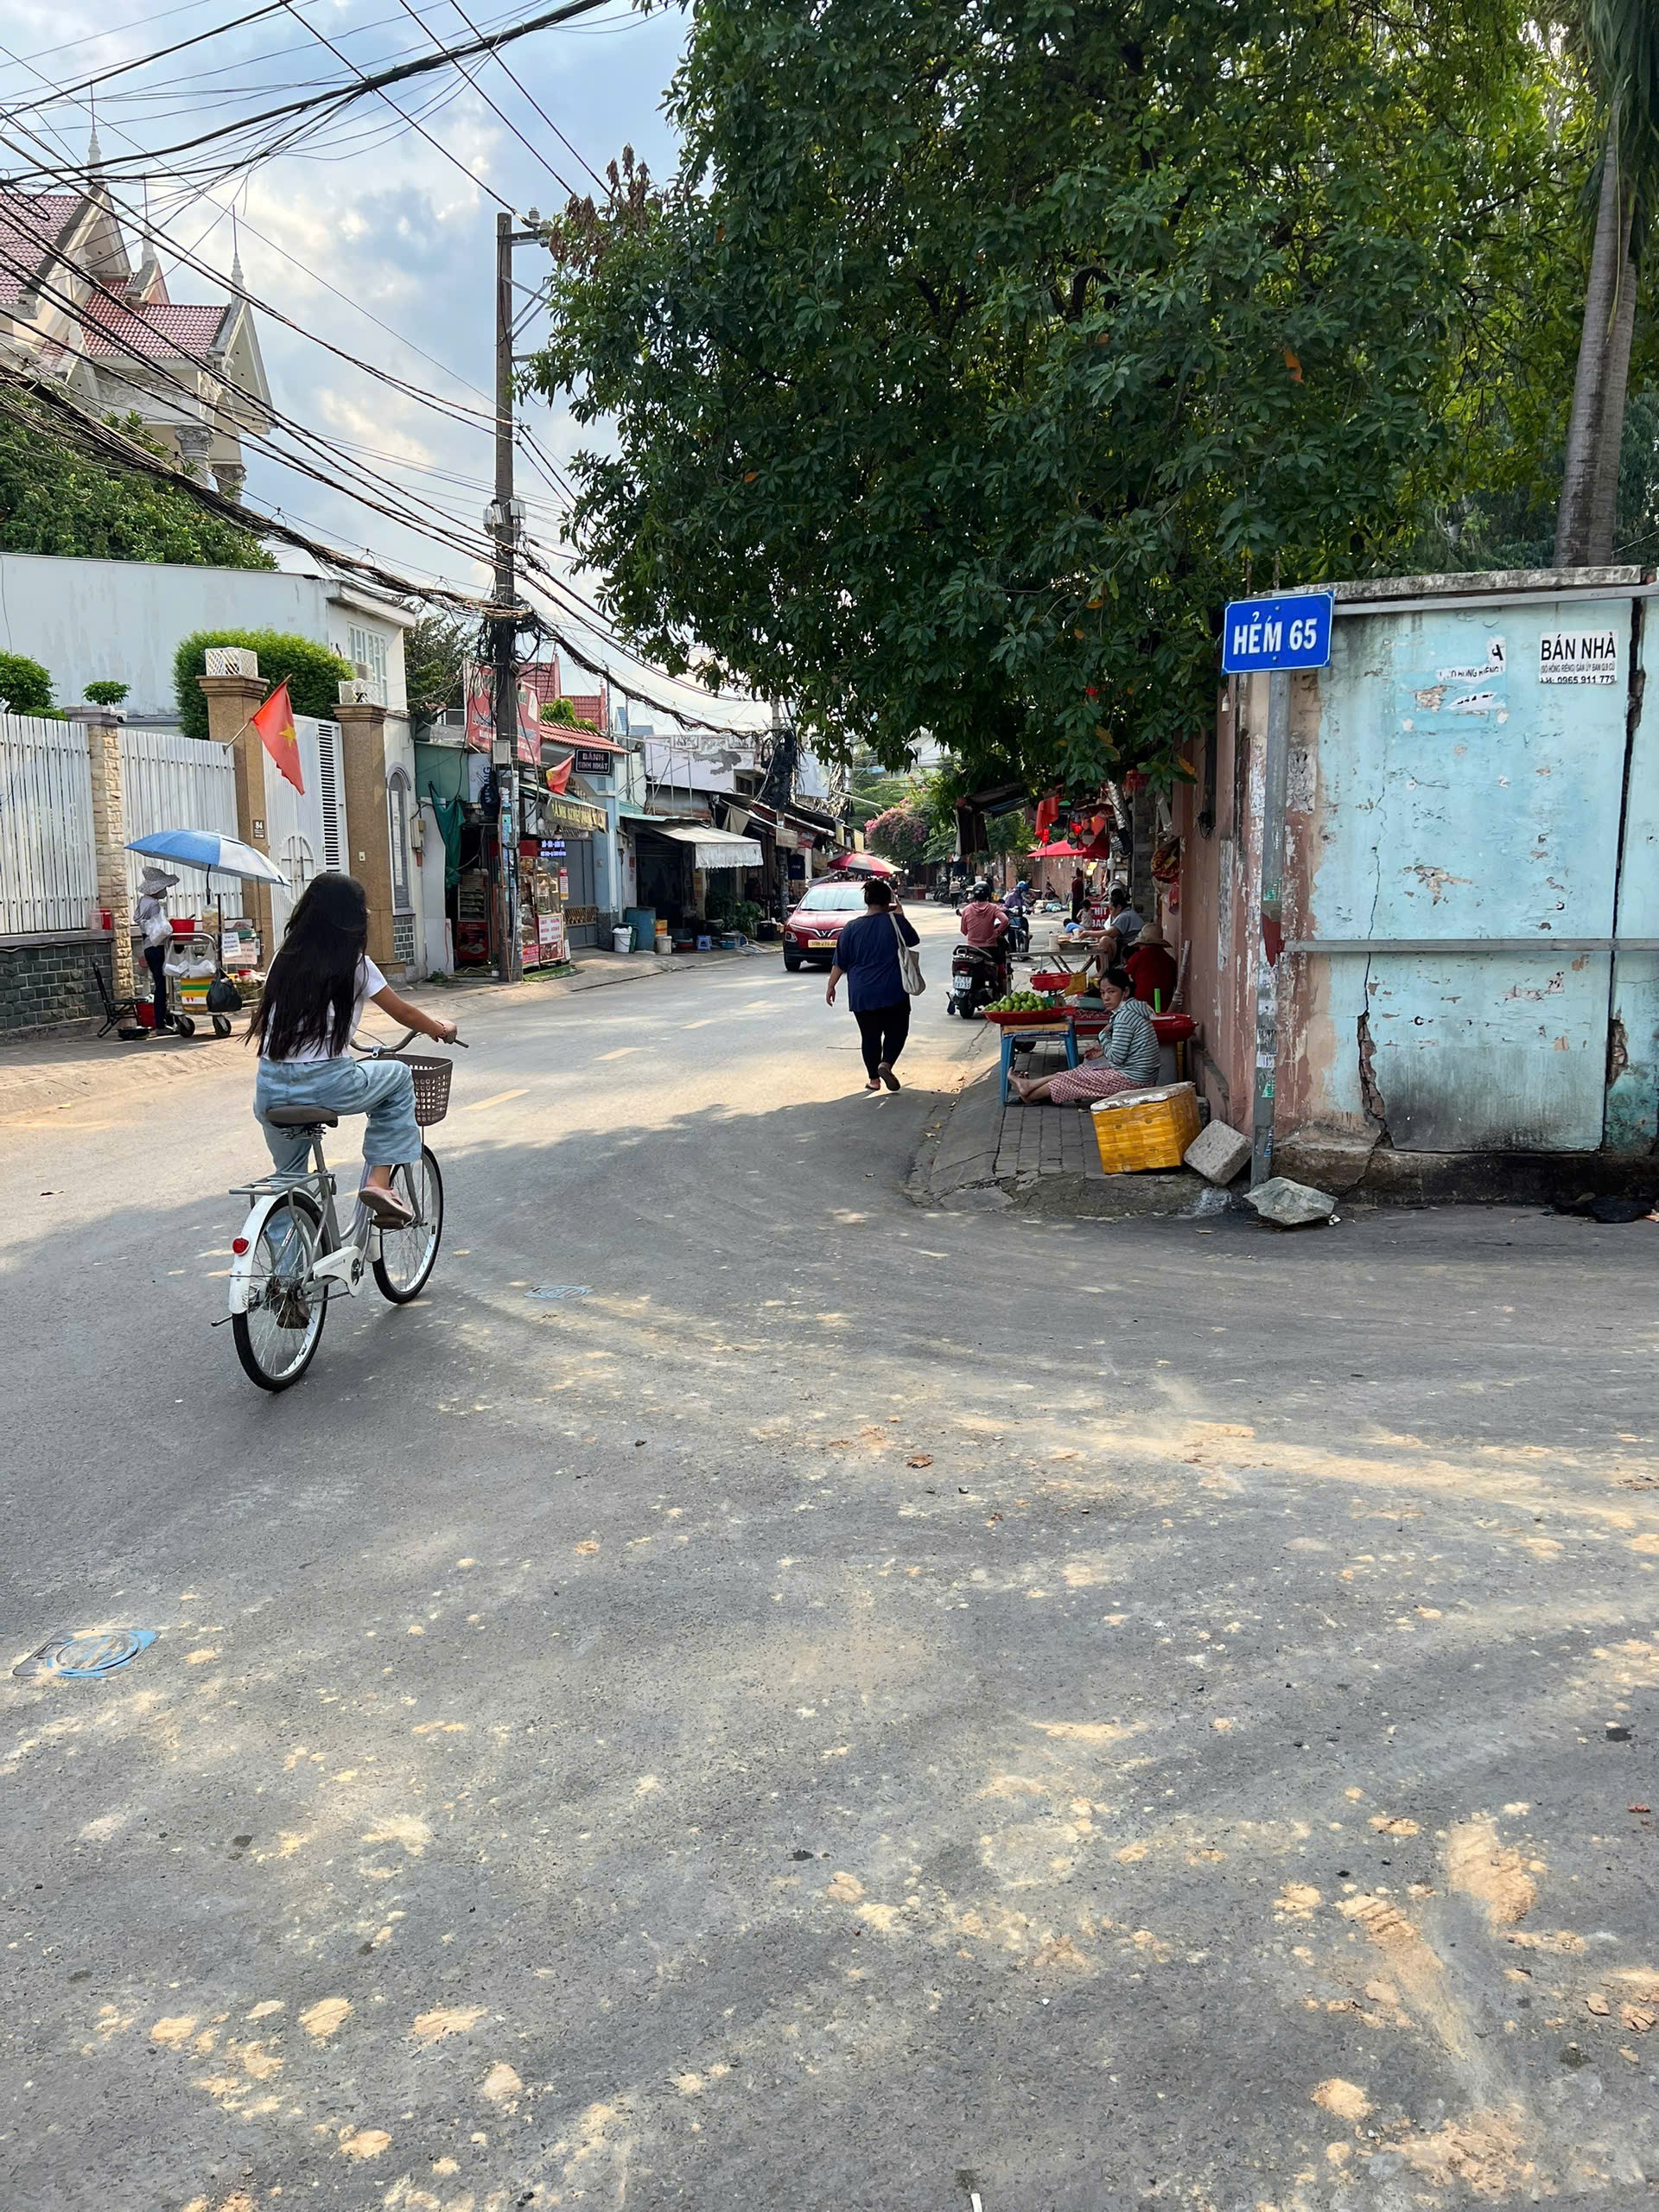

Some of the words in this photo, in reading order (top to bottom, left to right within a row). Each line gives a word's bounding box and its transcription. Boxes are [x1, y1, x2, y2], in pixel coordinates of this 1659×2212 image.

[1289, 618, 1318, 651] 65
[1541, 633, 1576, 660] BÁN
[1581, 632, 1616, 658] NHÀ
[1557, 676, 1578, 684] 0965
[1580, 675, 1596, 683] 911
[1599, 675, 1615, 683] 779
[255, 821, 264, 830] 84
